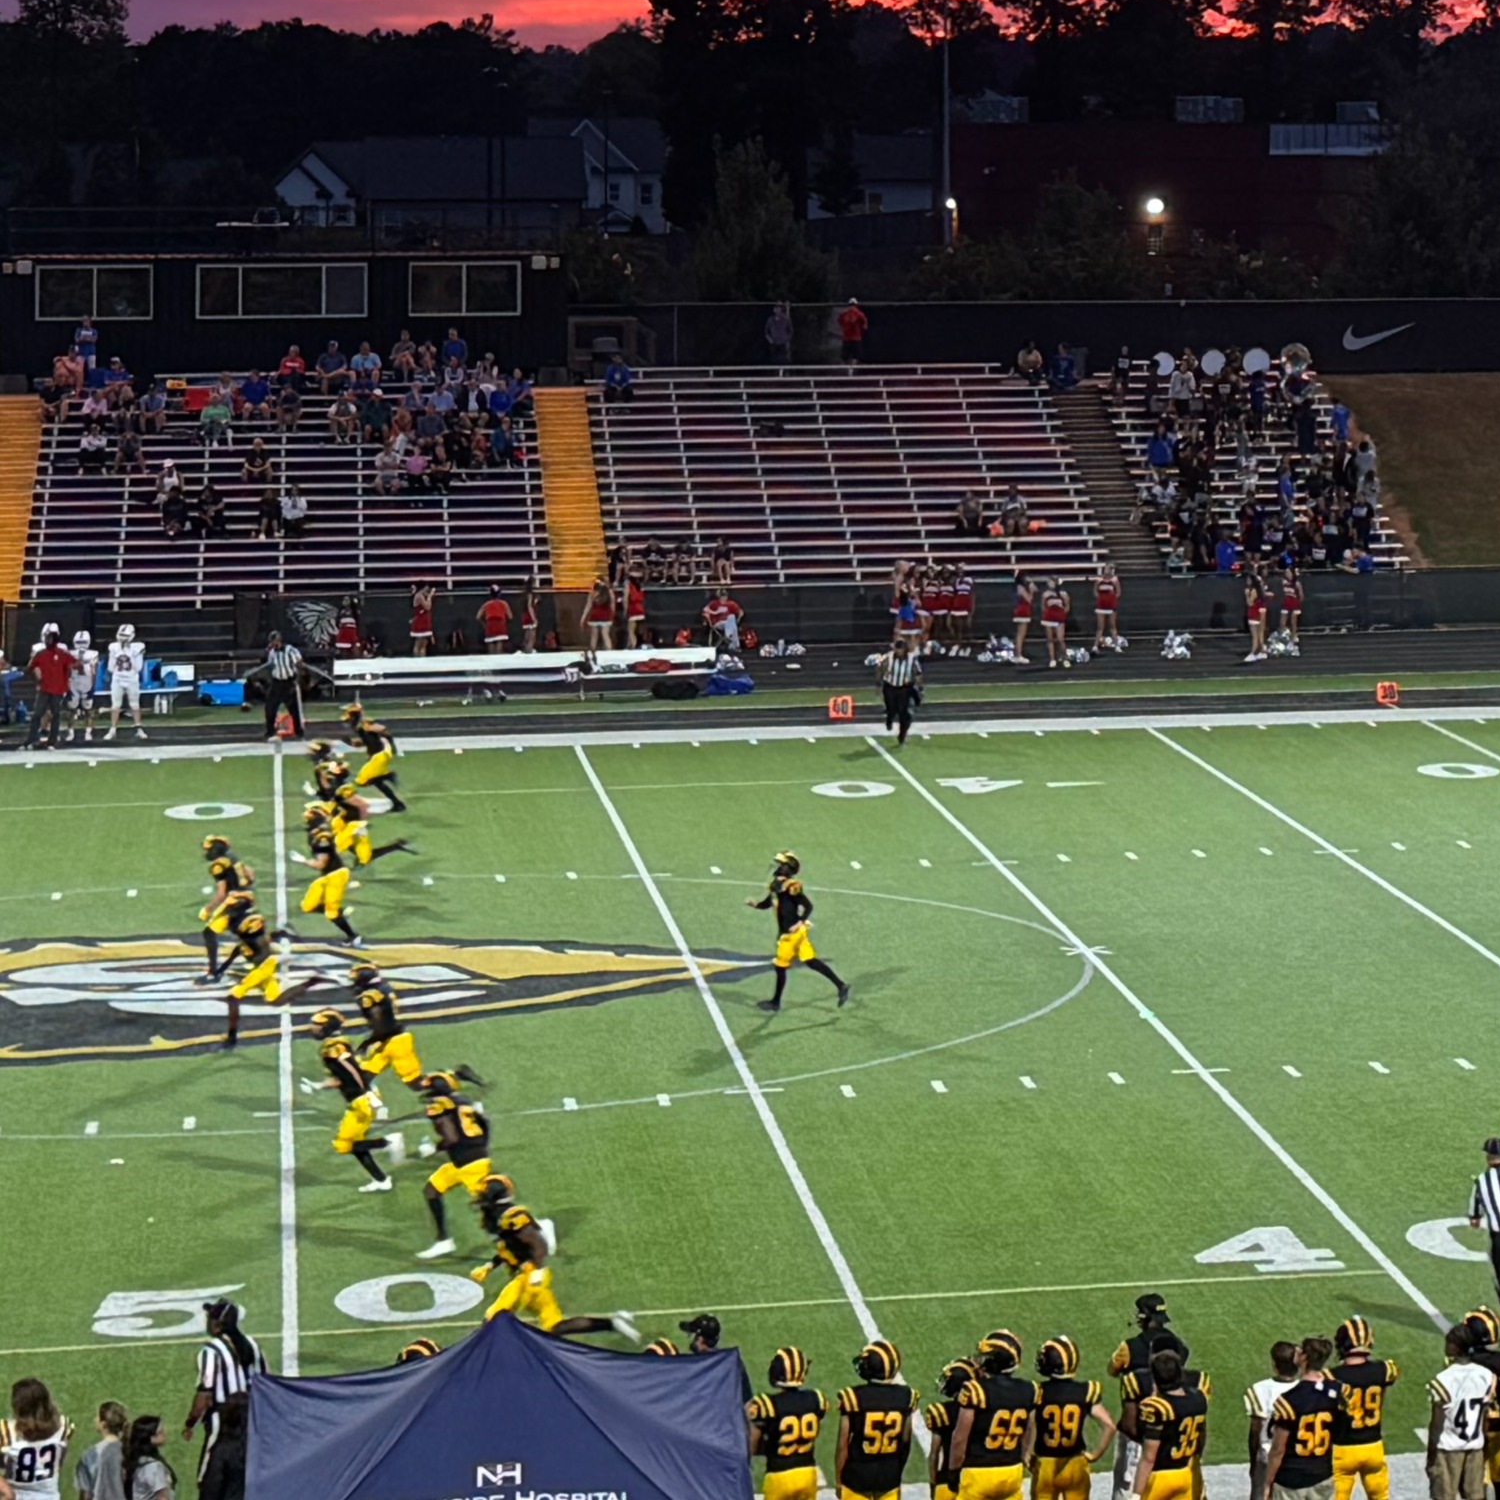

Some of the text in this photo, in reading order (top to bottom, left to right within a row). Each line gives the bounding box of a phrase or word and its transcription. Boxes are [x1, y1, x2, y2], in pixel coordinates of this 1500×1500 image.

[863, 1411, 903, 1455] 52
[1043, 1404, 1081, 1448] 39
[1171, 1414, 1205, 1459] 35
[1295, 1411, 1332, 1457] 56
[1454, 1397, 1484, 1442] 47
[16, 1444, 57, 1483] 83
